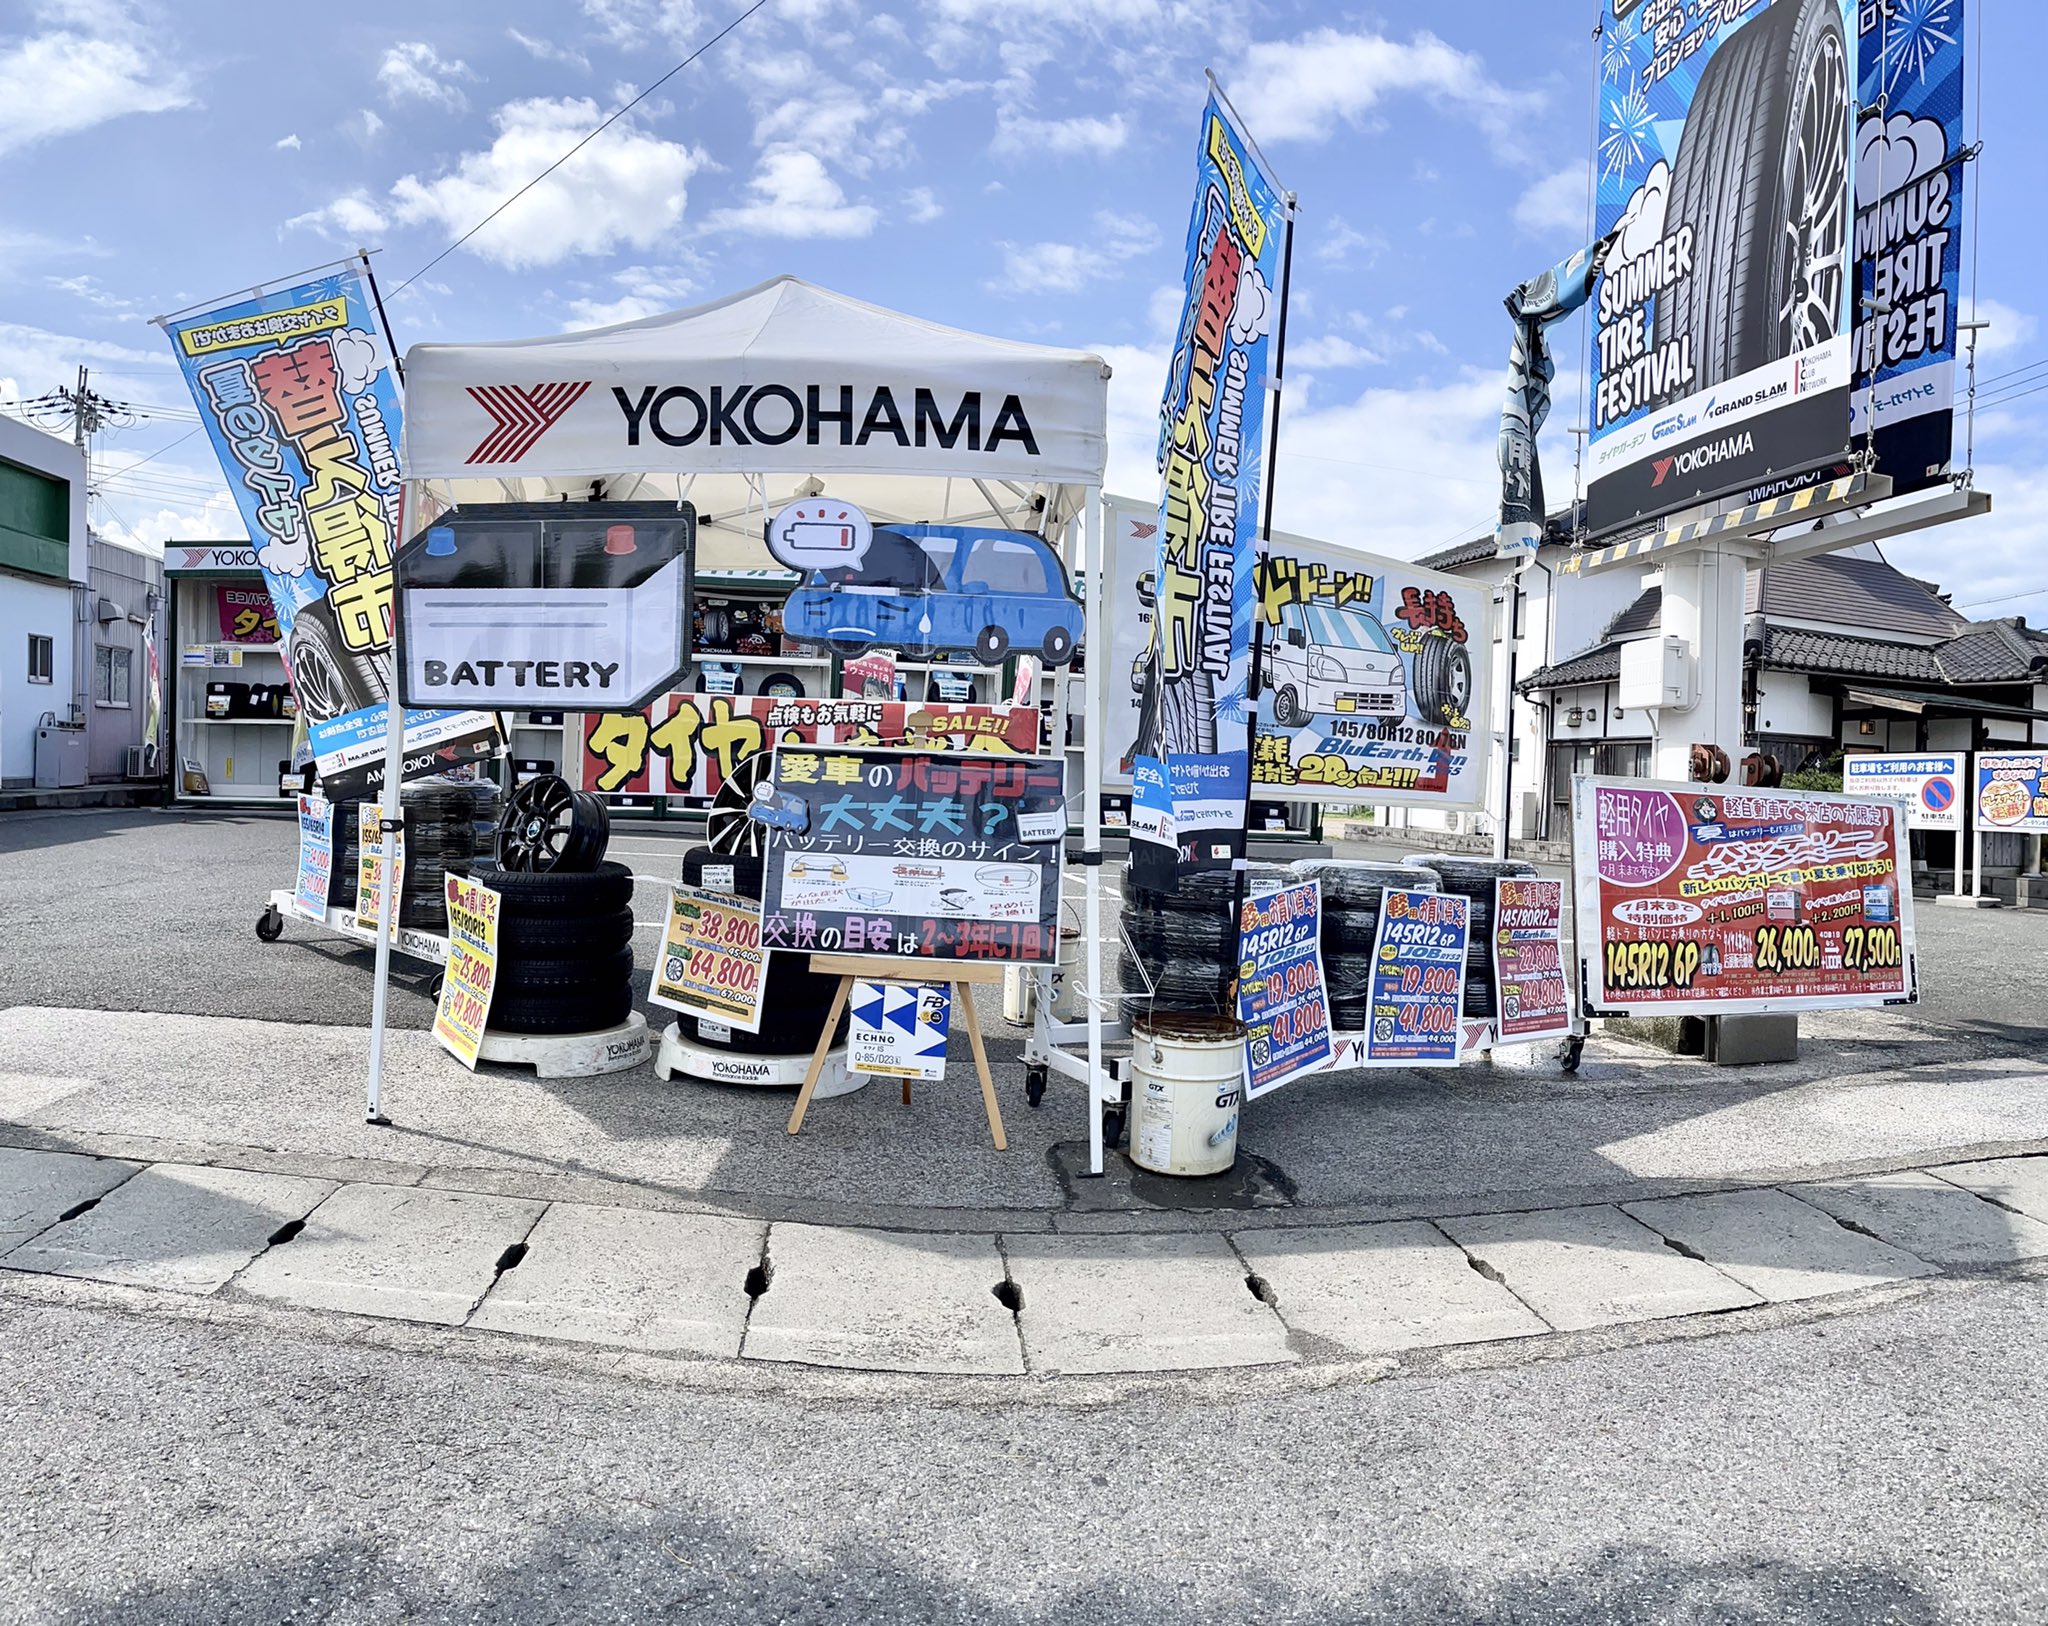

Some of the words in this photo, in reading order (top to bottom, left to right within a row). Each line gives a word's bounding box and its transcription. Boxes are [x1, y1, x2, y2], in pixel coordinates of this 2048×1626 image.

[1598, 224, 1694, 318] SUMMER
[1599, 313, 1647, 375] TIRE
[1596, 335, 1695, 429] FESTIVAL
[1800, 369, 1816, 380] CLUB
[1715, 396, 1754, 417] GRAND
[1755, 381, 1787, 403] SLAM
[611, 383, 1041, 456] YOKOHAMA
[1674, 431, 1754, 477] YOKOHAMA
[211, 550, 259, 566] YOKO
[226, 591, 270, 606] ヨコハマ
[1396, 587, 1468, 643] 長持ち
[424, 659, 619, 690] BATTERY
[767, 703, 883, 727] 点検もお気軽に
[932, 715, 1010, 735] SALE!!
[588, 699, 762, 791] タイヤ
[1330, 720, 1412, 742] 145/80R12
[1314, 737, 1468, 766] BluEarth-Van
[779, 753, 1059, 797] 愛車のバッテリー
[819, 793, 1008, 836] 大丈夫?
[1599, 790, 1669, 838] 軽用タイヤ
[1723, 797, 1889, 826] 軽自動車でご来店の方限定!
[1022, 828, 1057, 837] BATTERY
[1708, 831, 1873, 863] バッテリー
[772, 833, 1057, 864] バッテリー交換のサイン!
[1600, 840, 1672, 863] 購入特典
[1687, 842, 1889, 879] キャンペーン
[698, 910, 760, 950] 38,800
[1500, 909, 1549, 927] 145/80R12
[1627, 914, 1688, 925] 特別価格
[400, 930, 441, 956] YOKOHAMA
[1241, 923, 1294, 960] 145R12
[1294, 925, 1309, 943] 6P
[1384, 922, 1440, 946] 145R12
[1441, 933, 1456, 946] 6P
[1259, 946, 1297, 970] JOB
[1401, 947, 1442, 960] JOB
[1607, 942, 1670, 987] 145R12
[1674, 941, 1699, 987] 6P
[1757, 927, 1819, 972] 26,400円
[1844, 927, 1902, 972] 27,500円
[923, 996, 945, 1008] FB
[606, 1035, 645, 1055] YOKOHAMA
[856, 1033, 895, 1044] ECHNO
[711, 1061, 771, 1077] YOKOHAMA
[855, 1051, 894, 1065] Q-85/D23
[1148, 1084, 1165, 1092] GTX
